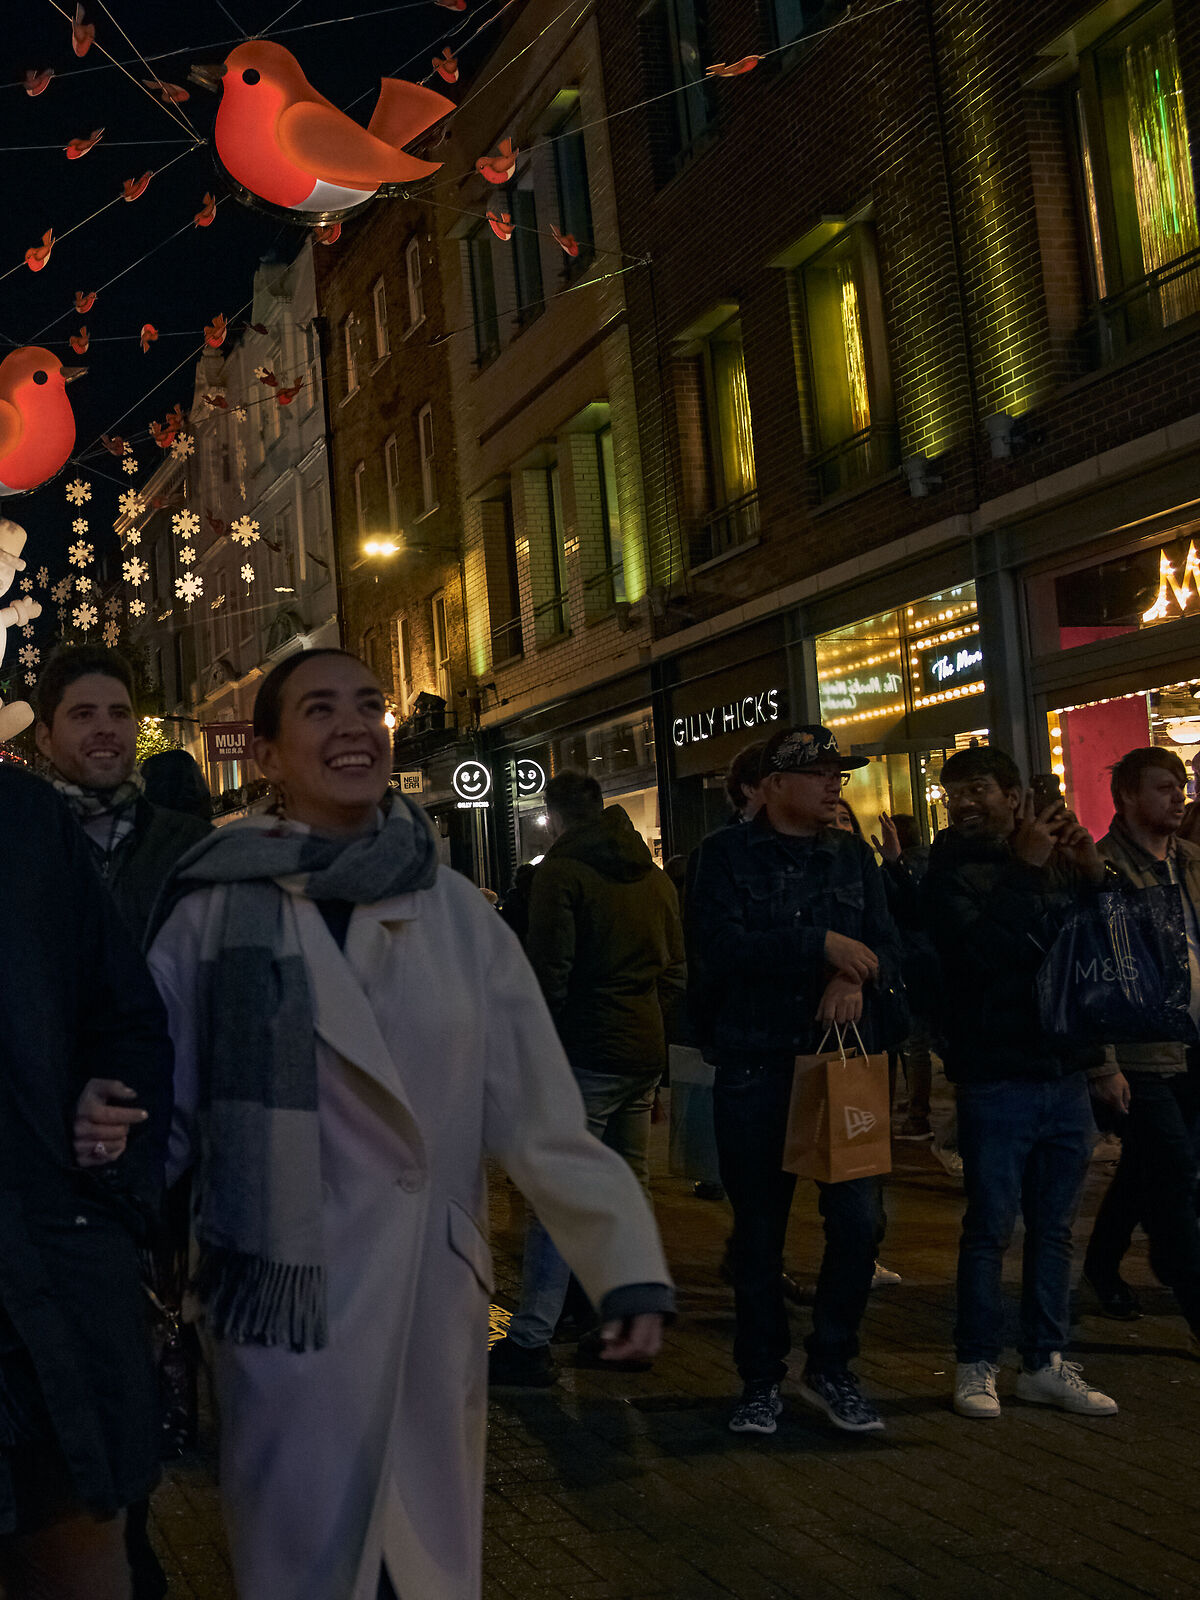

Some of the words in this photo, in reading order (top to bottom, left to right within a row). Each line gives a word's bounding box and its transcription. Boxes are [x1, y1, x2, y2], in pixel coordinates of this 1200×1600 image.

[931, 655, 955, 682] The
[672, 707, 715, 746] GILLY
[722, 689, 779, 733] HICKS
[215, 733, 246, 748] MUJI
[1075, 955, 1139, 984] M&S
